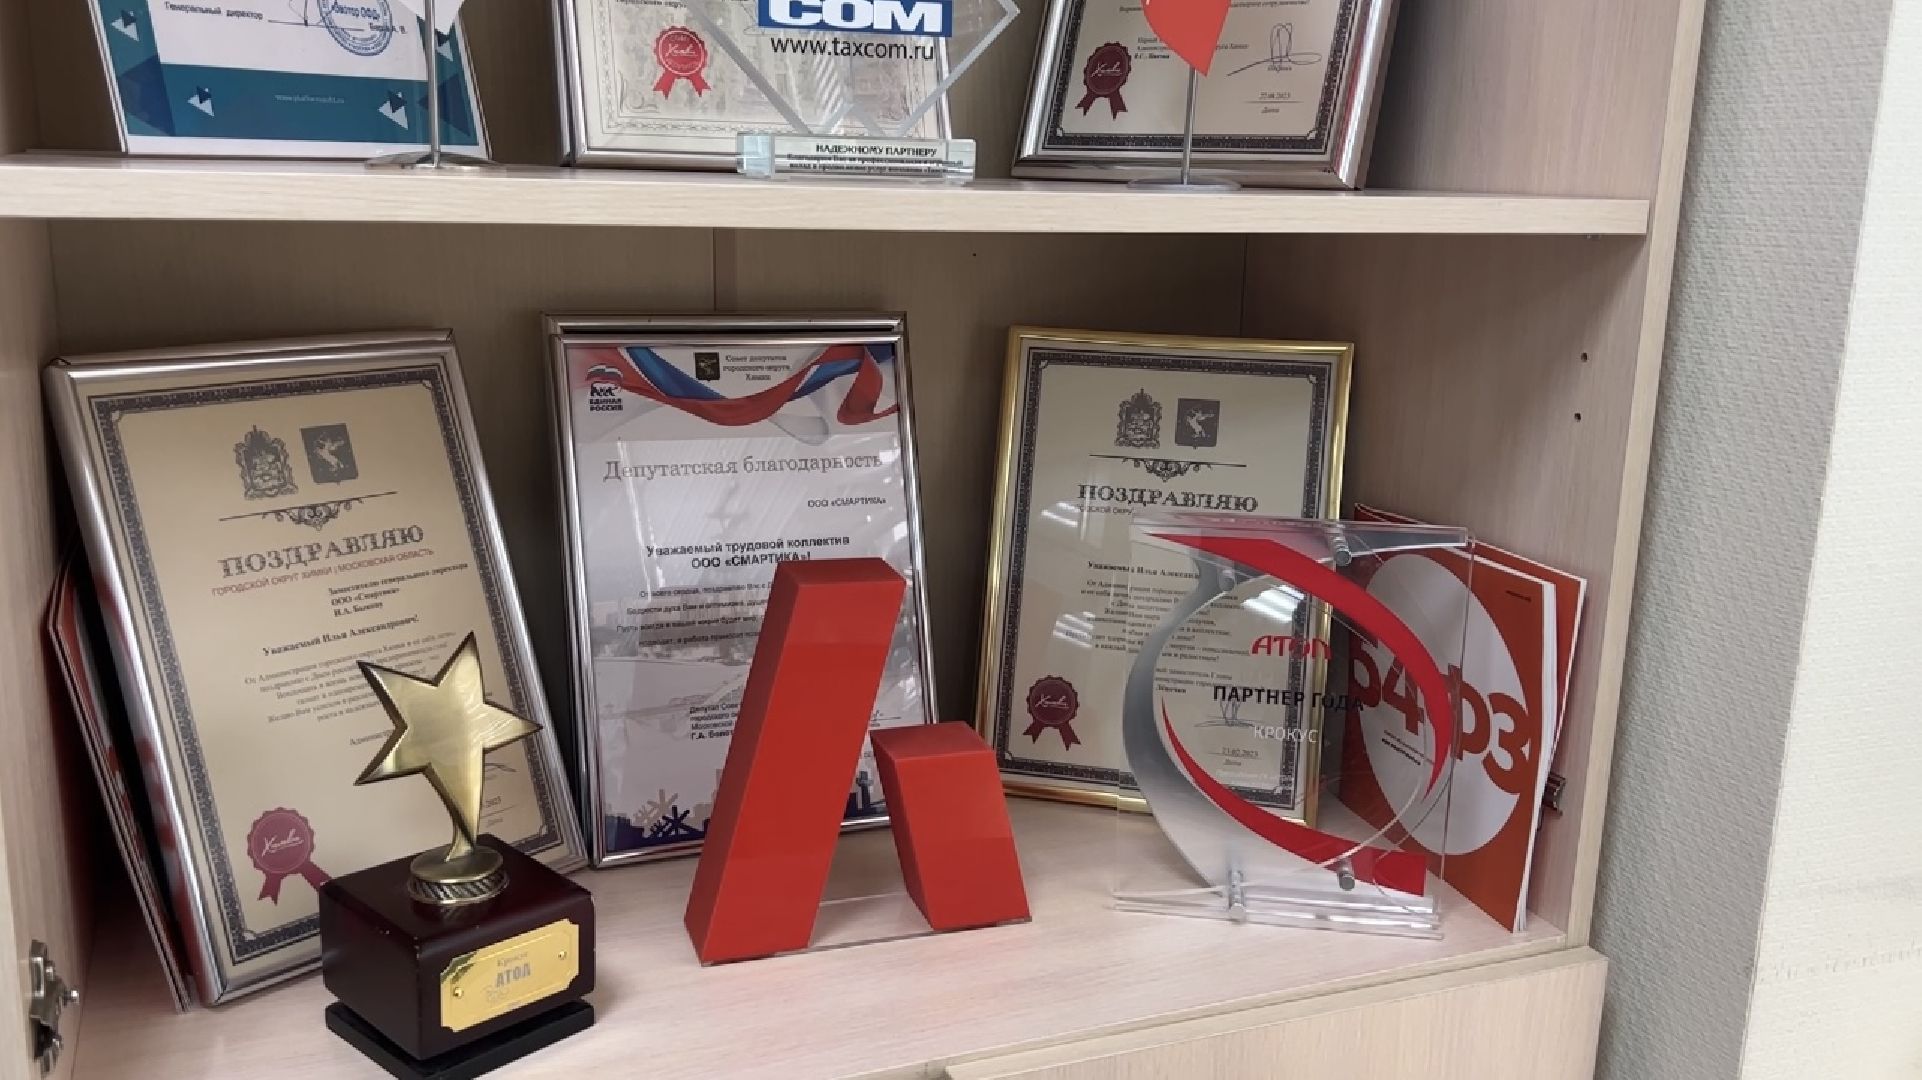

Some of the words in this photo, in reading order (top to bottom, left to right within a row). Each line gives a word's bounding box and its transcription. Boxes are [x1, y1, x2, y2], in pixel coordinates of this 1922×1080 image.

[771, 37, 934, 60] www.taxcom.ru
[816, 143, 884, 155] НАДЕЖНОМУ
[885, 147, 938, 158] ПАРТНЕРУ
[602, 460, 739, 482] Депутатская
[743, 455, 884, 473] благодарность
[1078, 484, 1259, 513] ПОЗДРАВЛЯЮ
[217, 524, 424, 579] ПОЗДРАВЛЯЮ
[646, 542, 723, 558] Уважаемый
[725, 539, 785, 555] трудовой
[787, 536, 850, 549] коллектив
[691, 557, 721, 569] ООО
[211, 578, 270, 597] ГОРОДСКОЙ
[271, 572, 299, 586] ОКРУГ
[1213, 685, 1305, 707] ПАРТНЕР
[1311, 692, 1364, 712] ГОДА
[1254, 725, 1319, 744] КРОКУС
